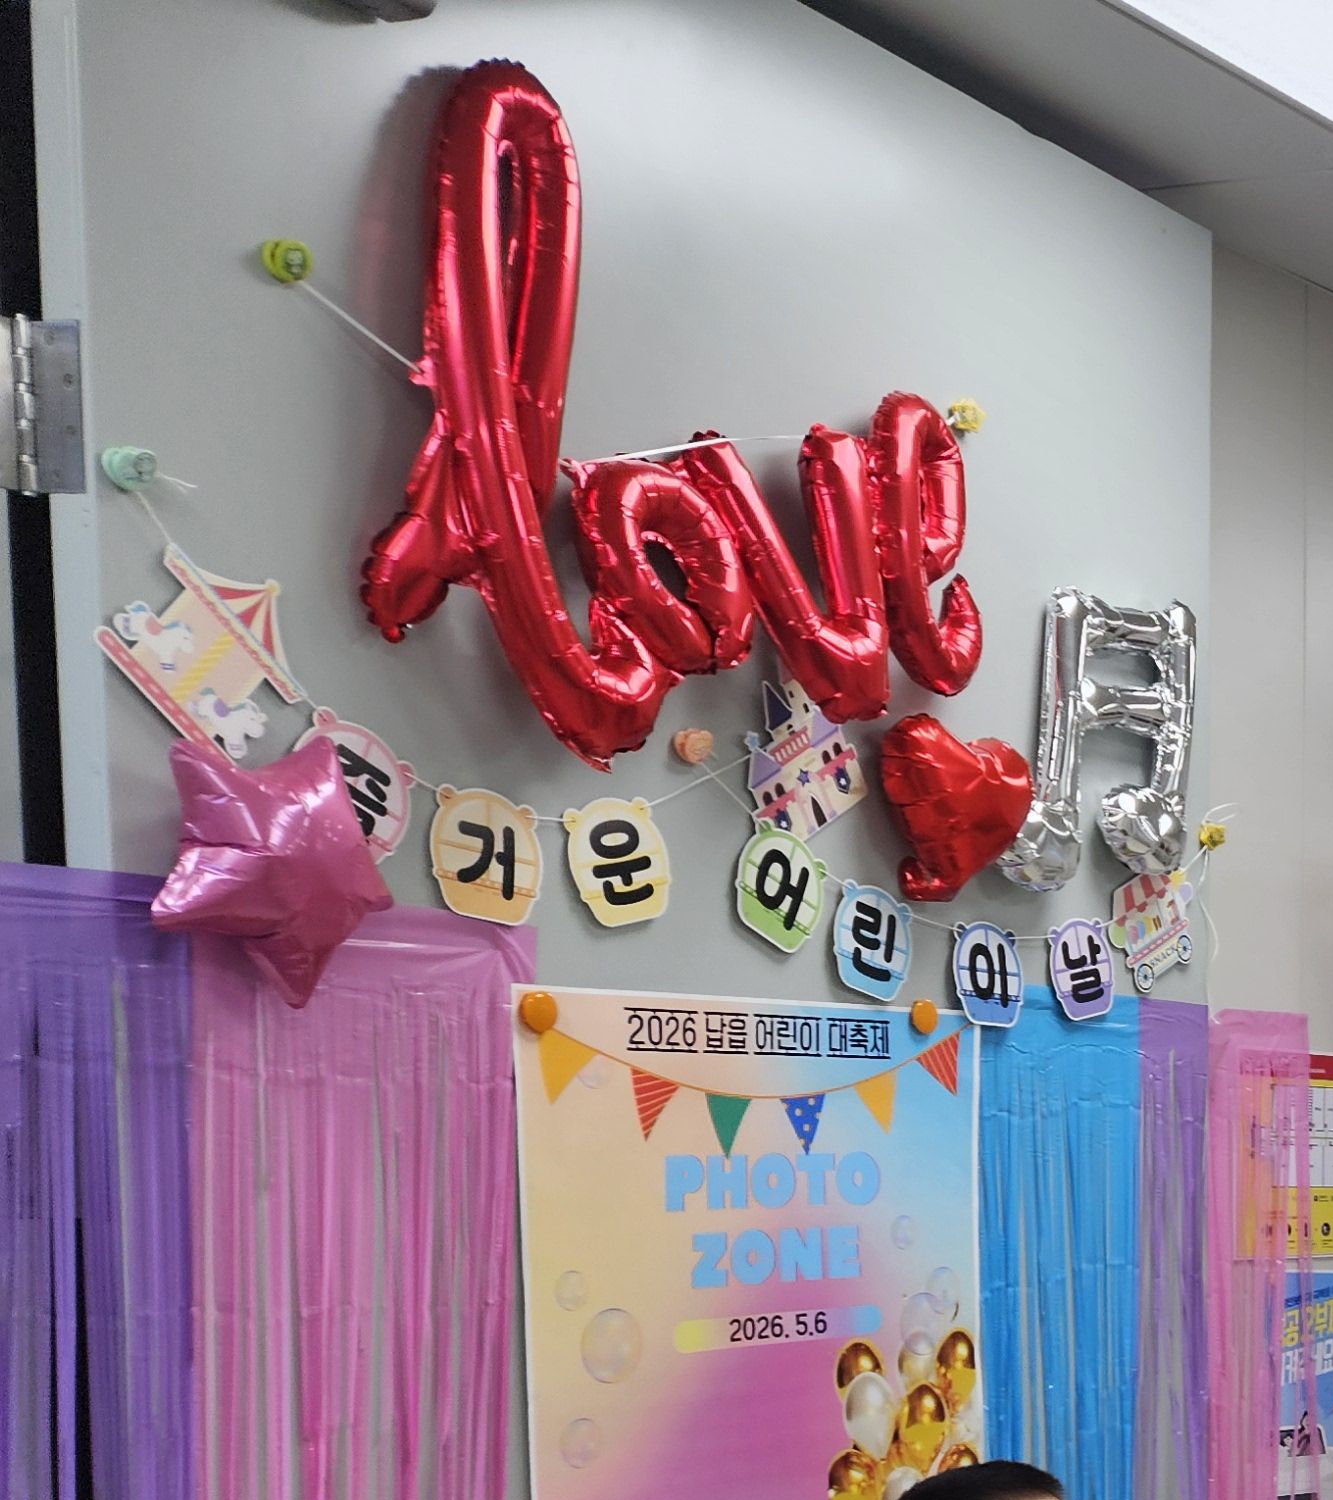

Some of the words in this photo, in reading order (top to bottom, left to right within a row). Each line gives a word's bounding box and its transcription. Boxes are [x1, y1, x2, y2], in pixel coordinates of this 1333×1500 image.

[626, 1012, 698, 1048] 2026
[704, 1015, 749, 1051] 납읍
[754, 1017, 821, 1053] 어린이
[828, 1019, 890, 1056] 대축제
[664, 1151, 881, 1212] PHOTO
[690, 1225, 862, 1289] ZONE
[728, 1315, 790, 1342] 2026.
[795, 1311, 828, 1336] 5.6
